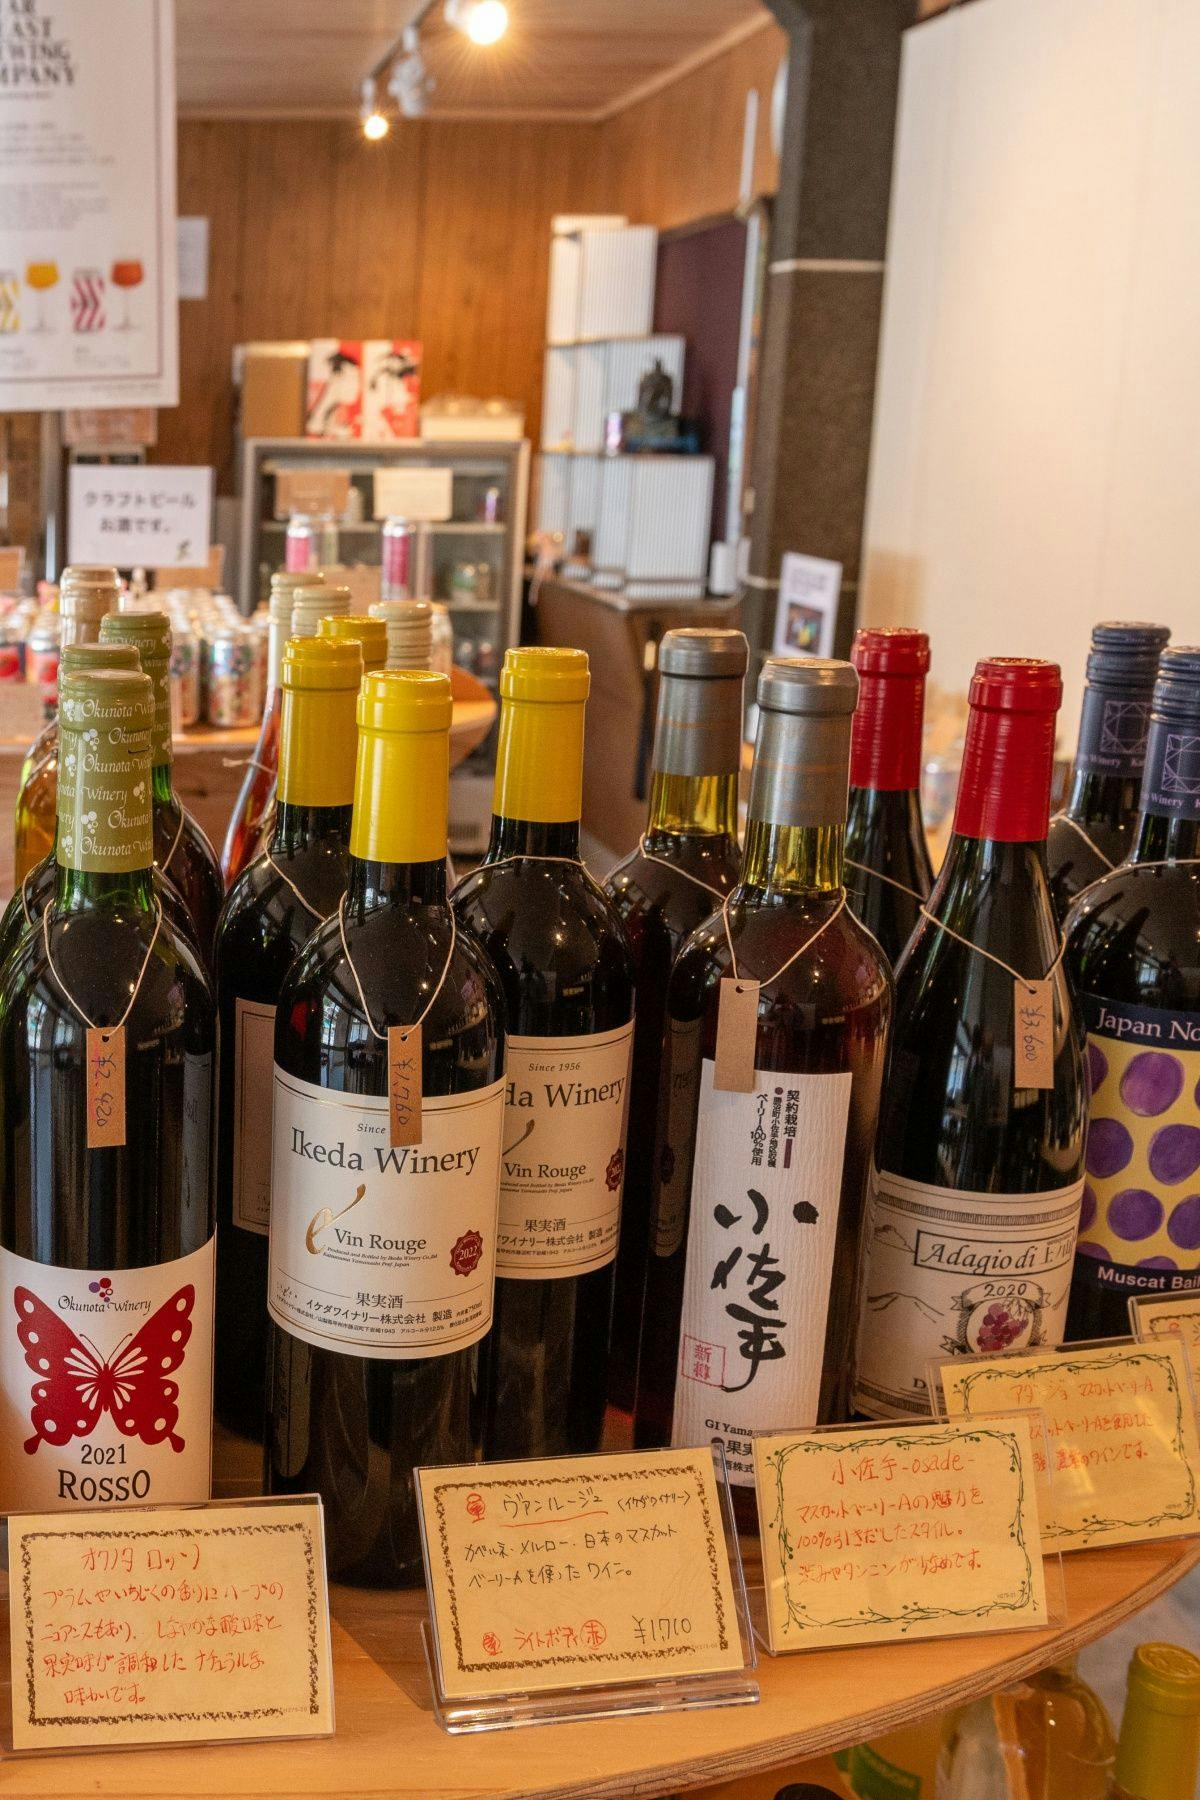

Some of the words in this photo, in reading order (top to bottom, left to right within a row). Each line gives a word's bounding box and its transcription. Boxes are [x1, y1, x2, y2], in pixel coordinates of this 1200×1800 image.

[81, 699, 133, 718] Okunota
[82, 754, 131, 773] Okunota
[80, 786, 128, 810] Winery
[79, 836, 132, 856] Okunota
[1096, 1008, 1161, 1038] Japan
[529, 1063, 555, 1071] Since
[558, 1062, 580, 1071] 1956
[544, 1075, 625, 1108] Winery
[784, 1090, 800, 1137] 契約栽培
[356, 1122, 386, 1134] Since
[291, 1126, 364, 1172] Ikeda
[374, 1146, 480, 1176] Winery
[504, 1162, 532, 1178] Vin
[538, 1164, 587, 1180] Rouge
[524, 1218, 566, 1233] 果実酒
[334, 1229, 364, 1248] Vin
[370, 1235, 427, 1255] Rouge
[497, 1232, 583, 1247] ワイナリー株式会社
[920, 1243, 1012, 1275] Adagio
[1098, 1266, 1165, 1289] Muscat
[1172, 1274, 1200, 1290] Bail
[356, 1292, 404, 1309] 果実酒
[984, 1283, 1027, 1298] 2020
[58, 1295, 105, 1312] Okunota
[107, 1300, 151, 1315] Winery
[705, 1418, 720, 1430] GI
[722, 1422, 753, 1437] Yama
[81, 1444, 127, 1466] 2021
